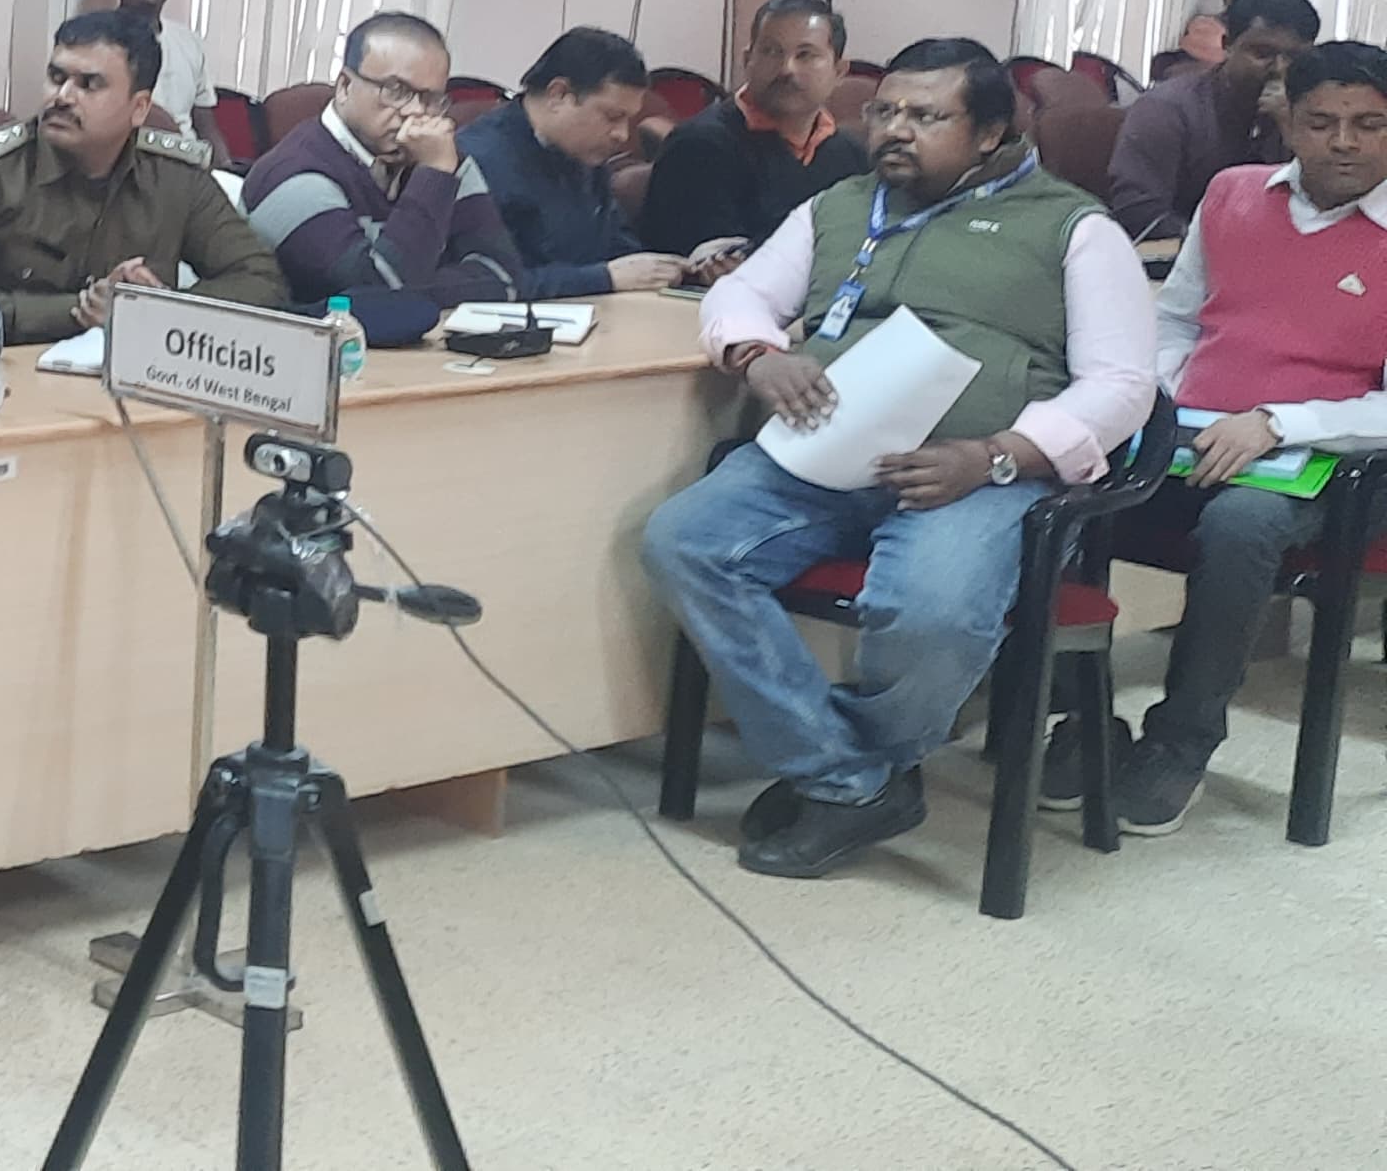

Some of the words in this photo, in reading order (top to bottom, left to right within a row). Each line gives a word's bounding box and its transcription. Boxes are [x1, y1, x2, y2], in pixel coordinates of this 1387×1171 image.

[165, 328, 276, 378] Officials
[146, 365, 182, 388] Govt.
[186, 374, 201, 391] of
[203, 378, 239, 401] West
[243, 388, 292, 413] Bengal
